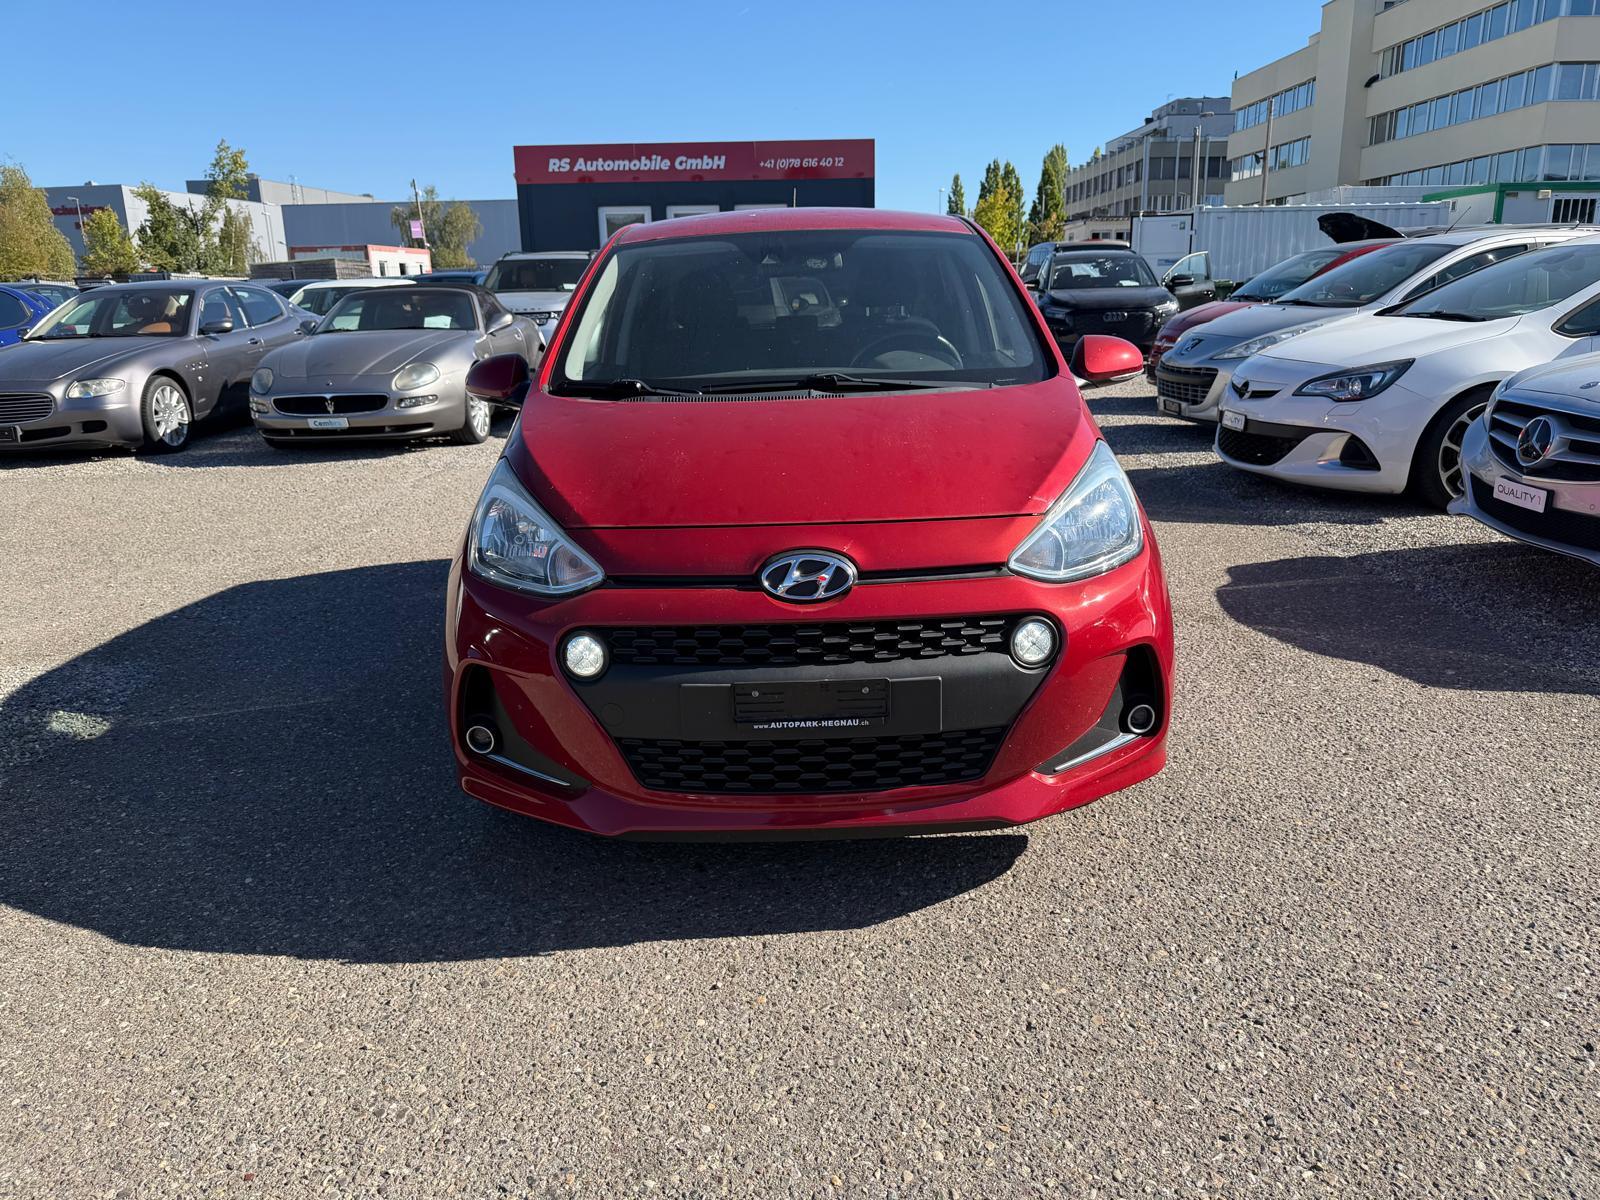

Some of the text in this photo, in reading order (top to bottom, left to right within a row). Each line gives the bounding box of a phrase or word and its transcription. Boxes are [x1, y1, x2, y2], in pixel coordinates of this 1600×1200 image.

[548, 154, 726, 173] RS Automobile GmbH
[760, 157, 845, 170] +41 (0)78 616 40 12
[1497, 484, 1536, 503] QUALITY
[753, 718, 870, 729] www.AUTOPARK-HEGNAU.ch
